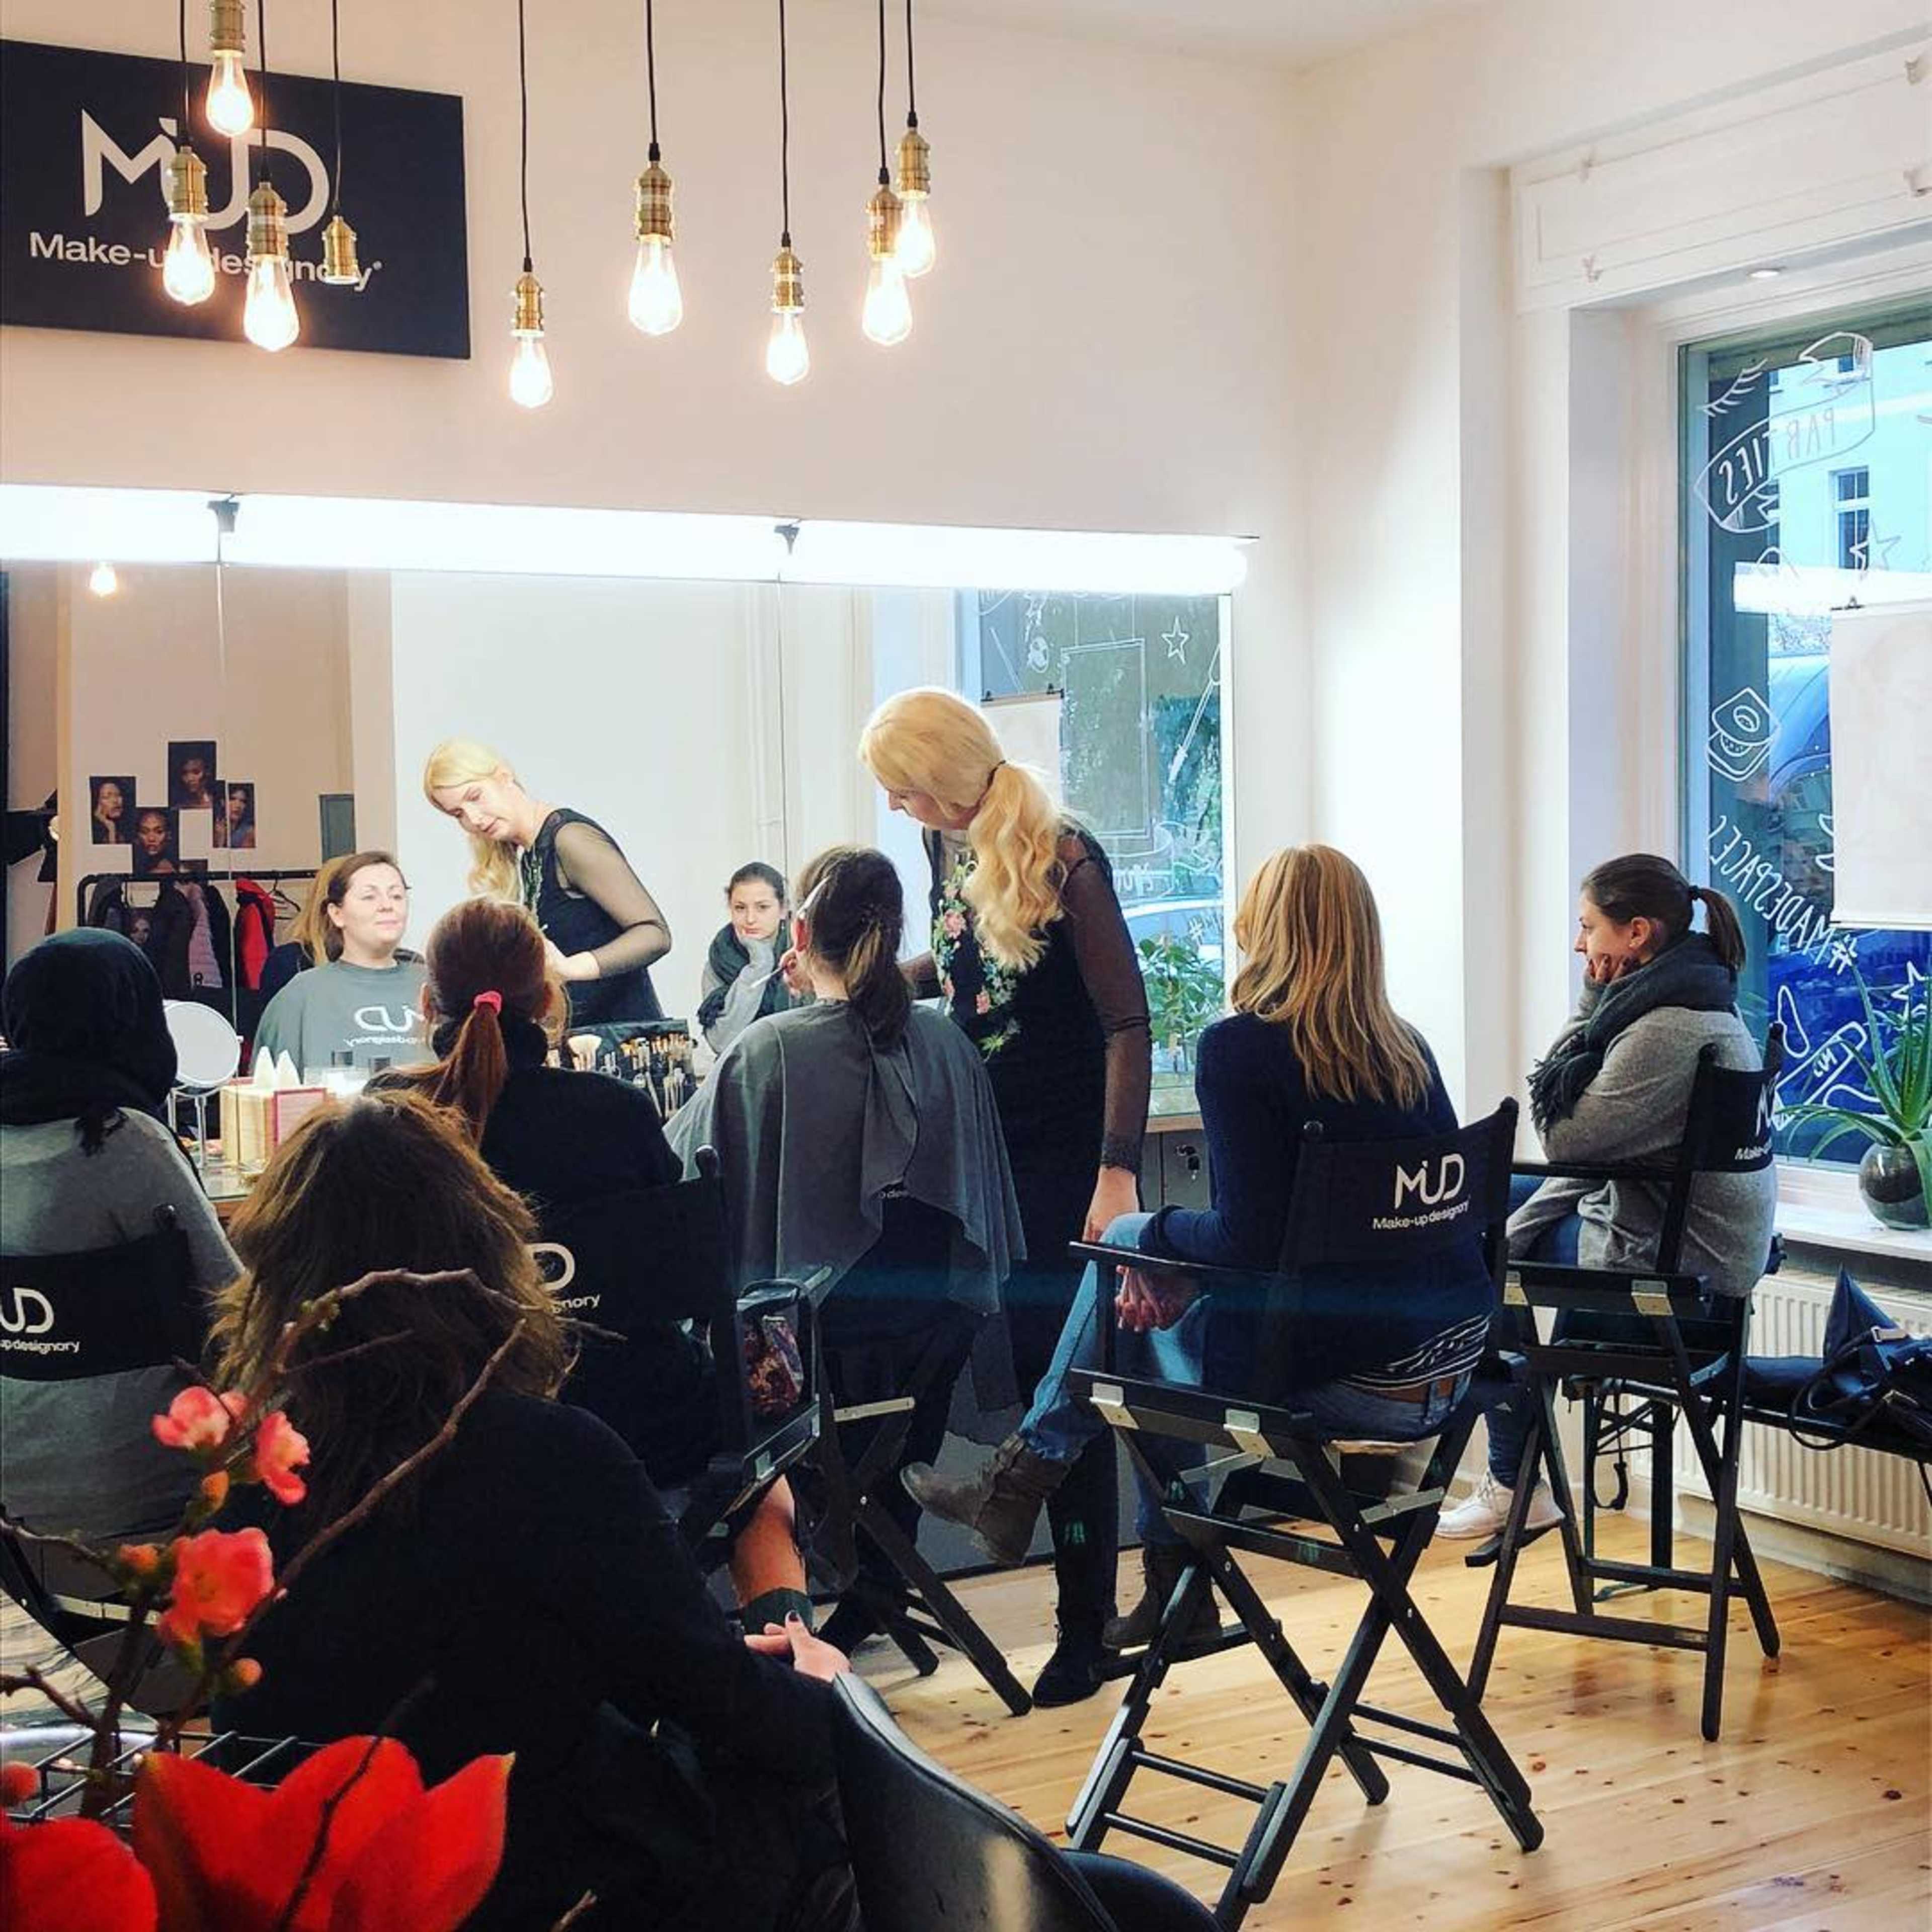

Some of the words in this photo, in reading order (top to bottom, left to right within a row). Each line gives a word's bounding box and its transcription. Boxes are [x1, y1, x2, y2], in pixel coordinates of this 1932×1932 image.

[82, 109, 330, 234] MUD
[1394, 1153, 1465, 1210] MUD
[0, 1287, 54, 1333] UD
